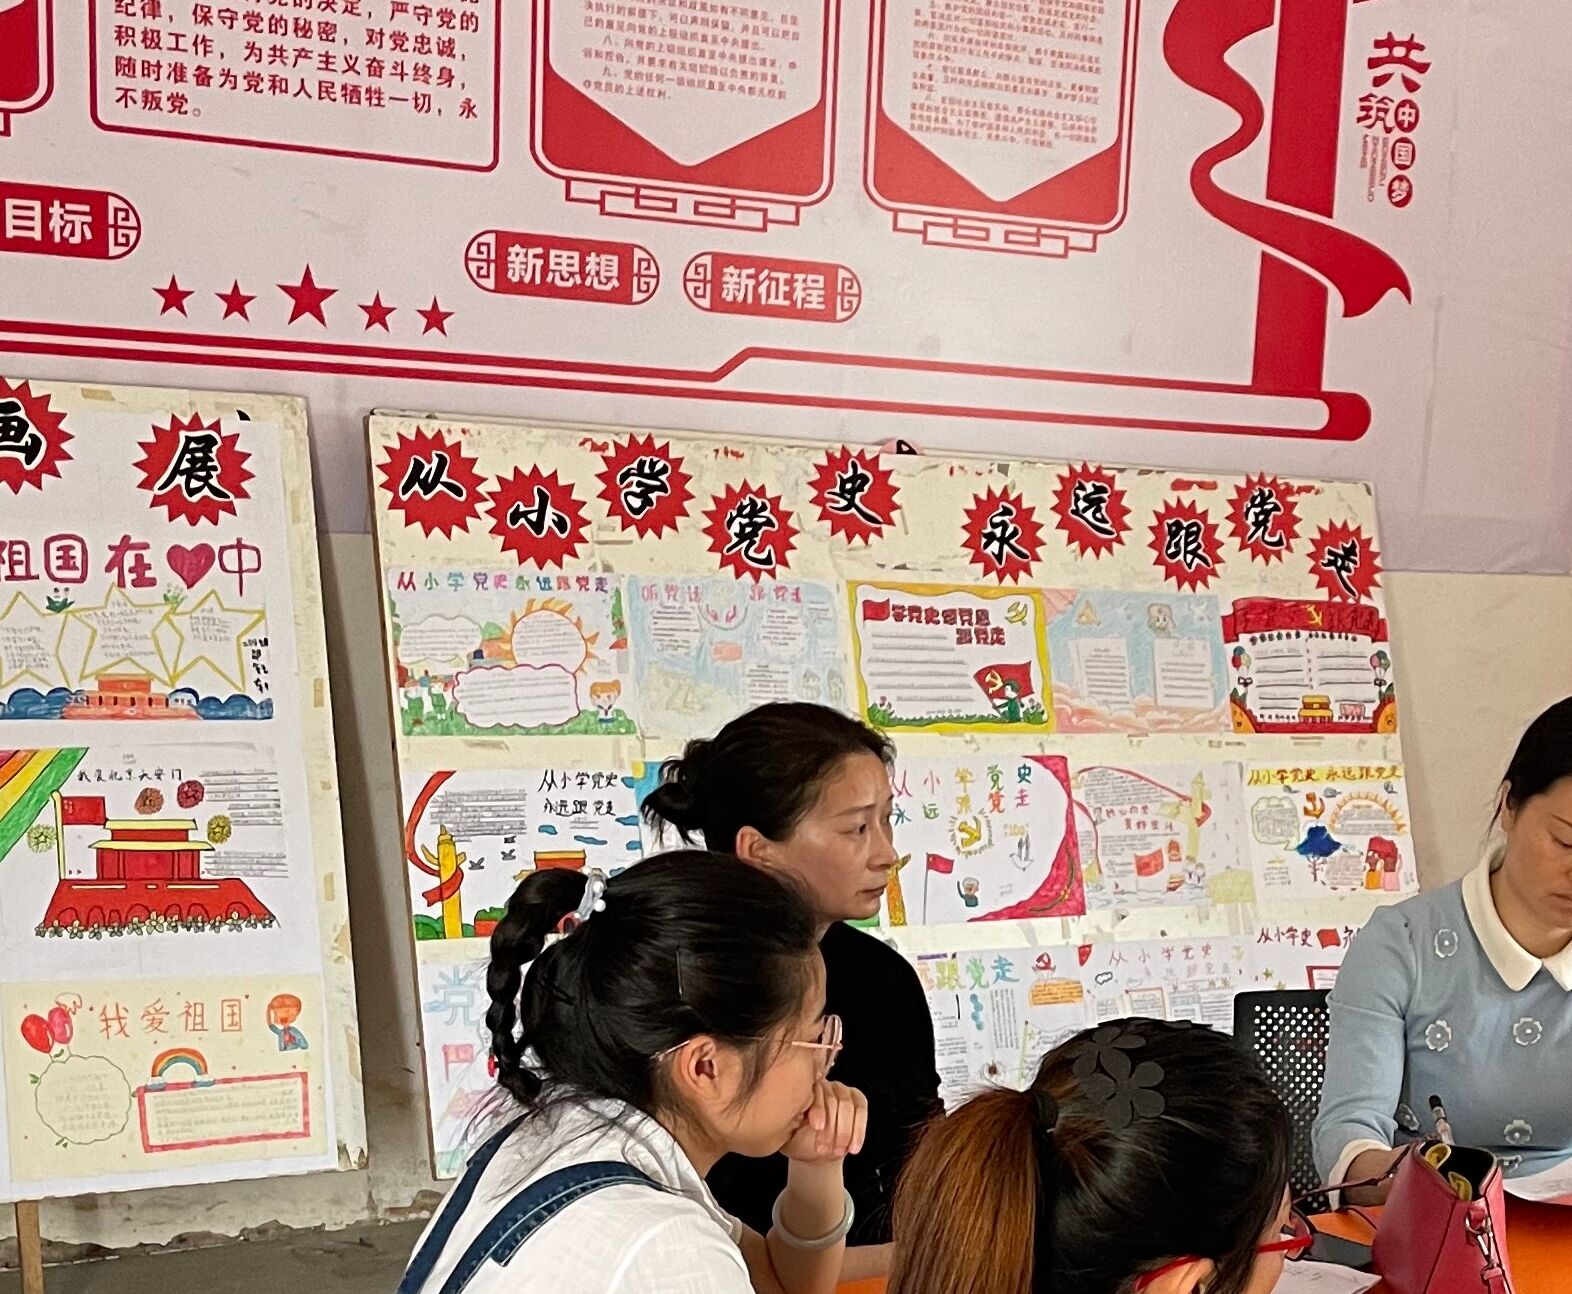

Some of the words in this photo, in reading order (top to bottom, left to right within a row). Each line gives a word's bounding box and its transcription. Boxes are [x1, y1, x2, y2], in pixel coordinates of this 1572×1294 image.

[114, 25, 466, 90] 积极工作，为共产主义奋斗终身，
[115, 55, 478, 119] 随时准备为党和人民牺牲一切，永
[115, 87, 201, 117] 不叛党。
[4, 198, 93, 246] 目标
[506, 243, 621, 292] 新思想
[721, 264, 826, 311] 新征程
[217, 537, 262, 597] 中
[537, 769, 618, 793] 从小学党史
[99, 1000, 244, 1038] 我爱祖国
